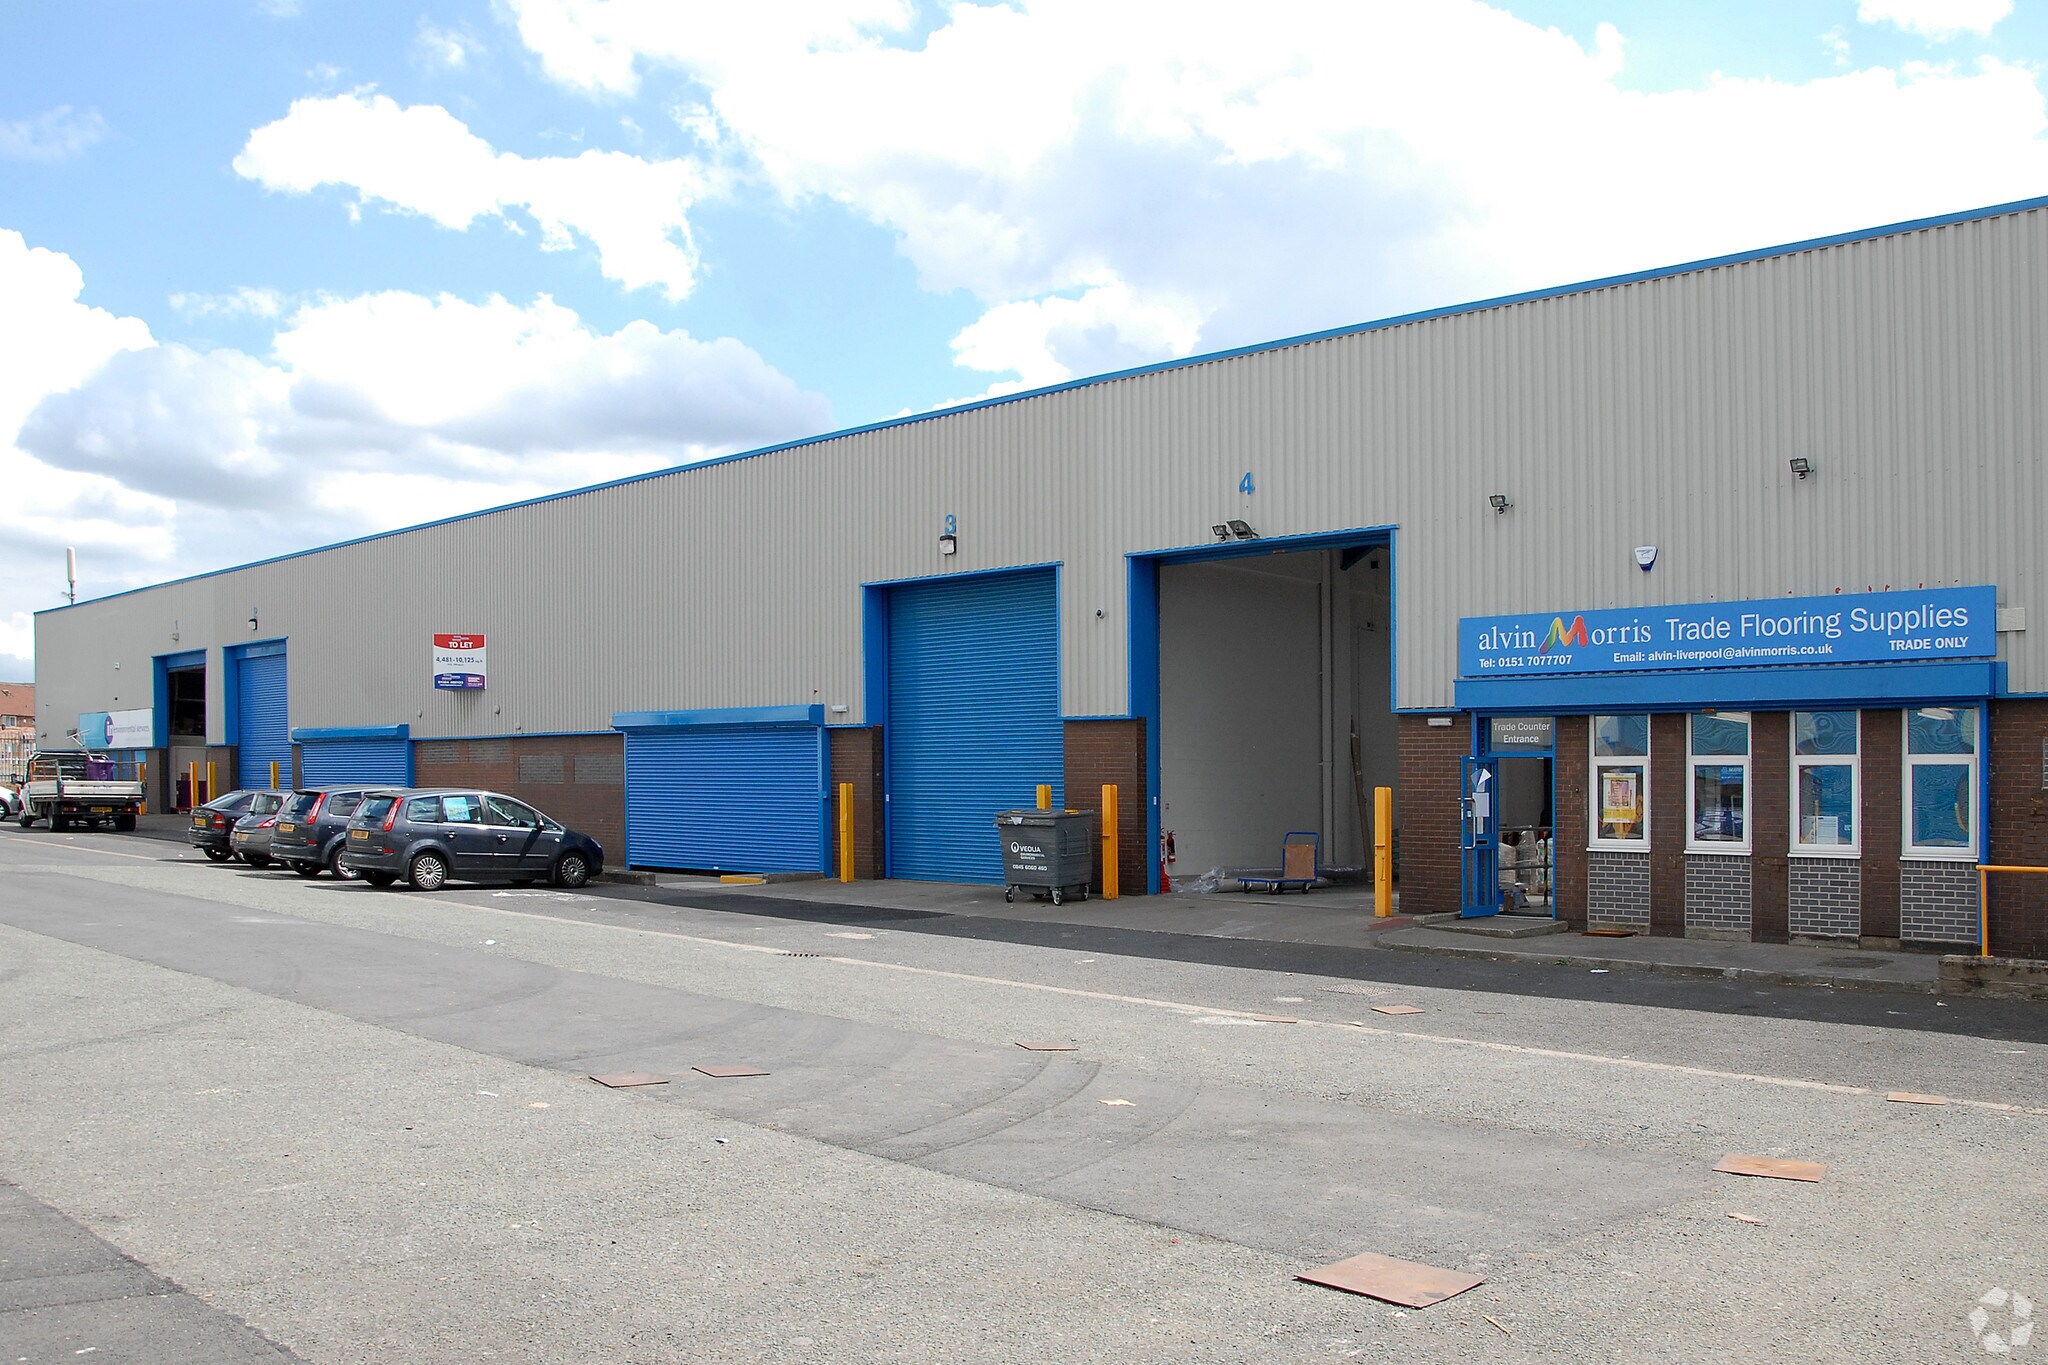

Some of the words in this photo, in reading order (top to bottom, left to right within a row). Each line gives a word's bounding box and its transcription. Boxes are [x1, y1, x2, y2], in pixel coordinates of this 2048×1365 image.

[1239, 471, 1255, 495] 4
[945, 514, 956, 534] 3
[1665, 616, 1731, 641] Trade
[1740, 611, 1842, 639] Flooring
[1850, 603, 1969, 635] Supplies
[1478, 625, 1536, 651] alvin
[1889, 638, 1931, 651] TRADE
[1935, 636, 1969, 649] ONLY
[1479, 658, 1496, 668] Tel:
[1498, 657, 1524, 667] 0151
[1527, 655, 1573, 666] 7077707
[1613, 651, 1645, 663] Email:
[1648, 643, 1833, 661] alvin-liverpool@alvinmorris.co.uk
[1493, 722, 1516, 731] Trade
[1517, 722, 1551, 731] Counter
[1503, 734, 1540, 743] Entrance
